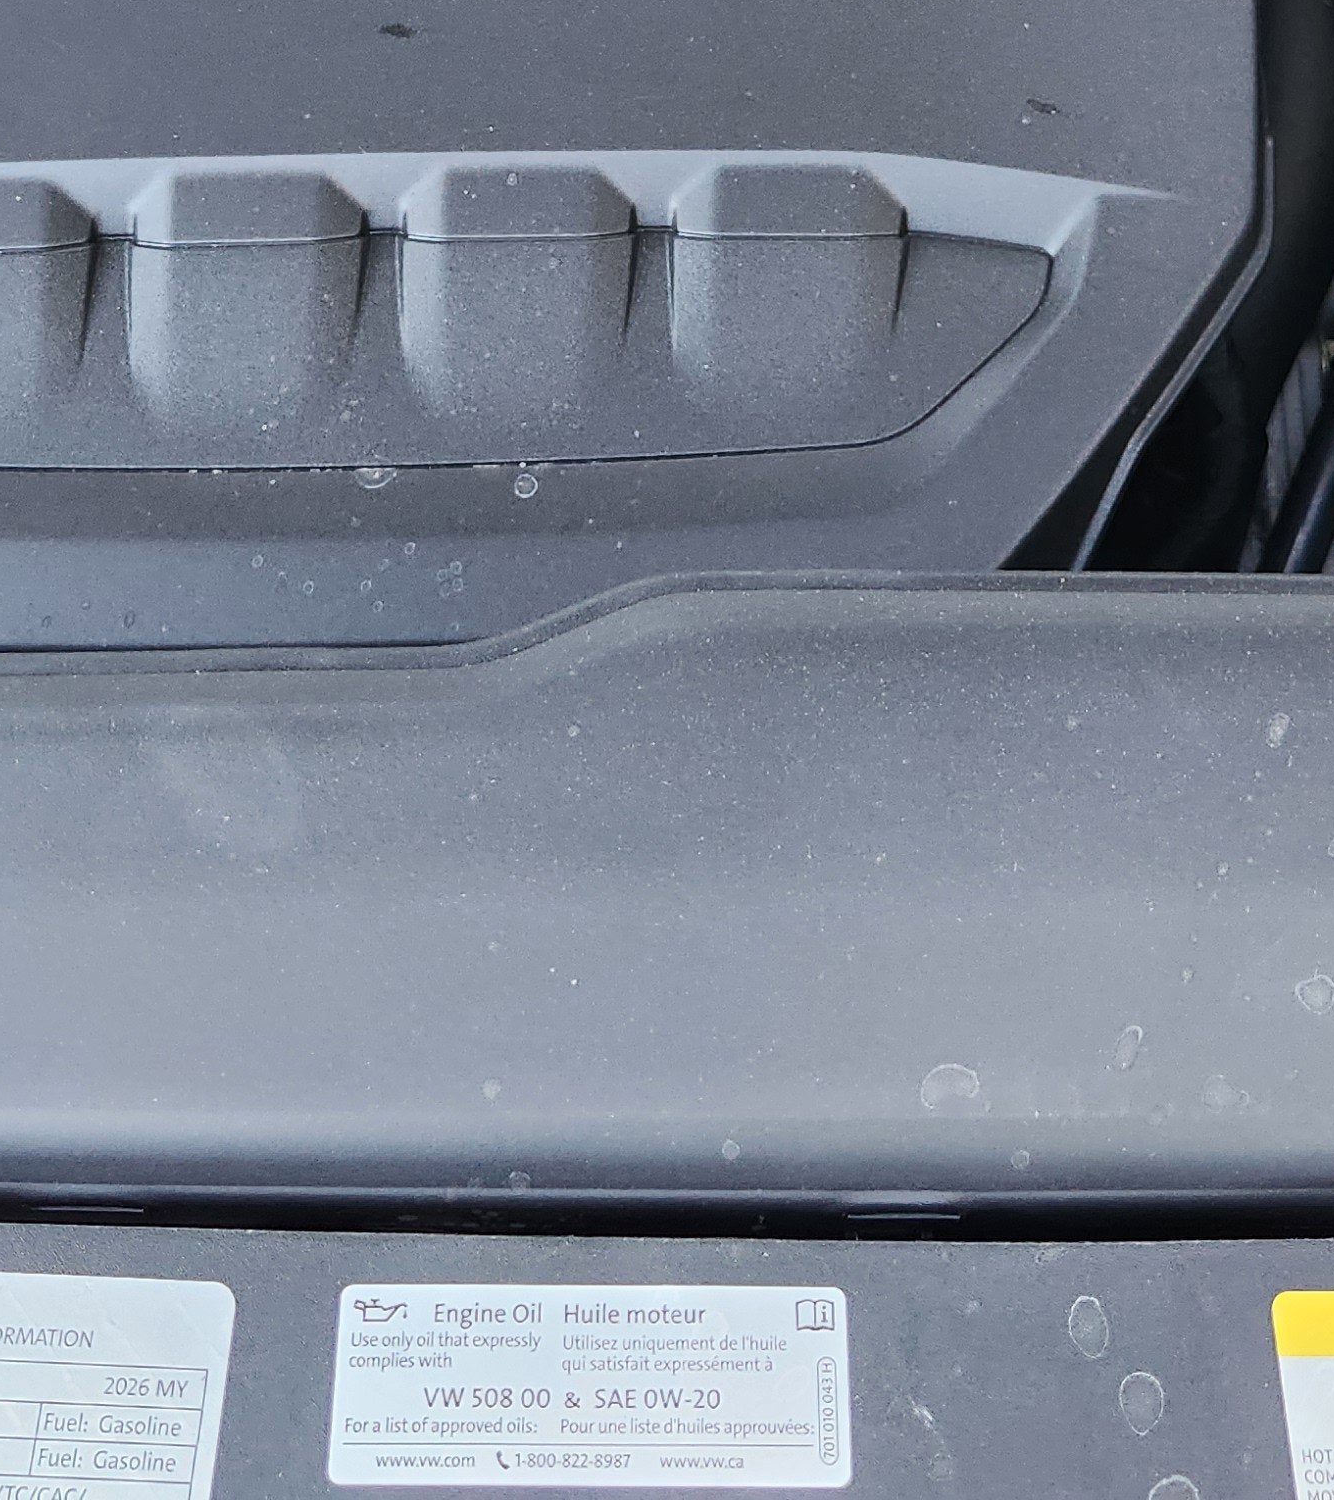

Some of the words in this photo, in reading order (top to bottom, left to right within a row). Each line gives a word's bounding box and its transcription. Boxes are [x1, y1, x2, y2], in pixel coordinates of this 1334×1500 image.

[434, 1302, 507, 1330] Engine
[512, 1301, 543, 1324] Oil
[563, 1302, 621, 1325] Huile
[626, 1305, 707, 1325] moteur
[350, 1332, 379, 1348] Use
[381, 1332, 414, 1352] only
[416, 1331, 435, 1348] oil
[437, 1331, 469, 1349] that
[471, 1332, 543, 1353] expressly
[562, 1334, 618, 1352] Utilisez
[622, 1336, 716, 1356] uniquement
[719, 1336, 739, 1352] de
[741, 1334, 788, 1352] l'huile
[348, 1352, 415, 1373] complies
[417, 1353, 453, 1369] with
[561, 1357, 587, 1375] qui
[589, 1356, 651, 1373] satisfait
[653, 1357, 761, 1376] expressément
[764, 1357, 774, 1373] à
[104, 1375, 150, 1397] 2026
[155, 1378, 190, 1399] MY
[423, 1386, 466, 1409] VW
[472, 1386, 514, 1409] 508
[520, 1387, 551, 1410] 00
[563, 1391, 581, 1410] &
[594, 1388, 637, 1409] SAE
[643, 1388, 722, 1410] 0W-20
[820, 1376, 835, 1404] 043
[42, 1411, 89, 1434] Fuel:
[98, 1414, 183, 1437] Gasoline
[344, 1416, 369, 1434] For
[371, 1420, 382, 1434] a
[384, 1416, 408, 1434] list
[411, 1416, 430, 1434] of
[429, 1417, 503, 1438] approved
[506, 1417, 539, 1434] oils:
[559, 1417, 595, 1435] Pour
[597, 1420, 627, 1435] une
[630, 1417, 661, 1435] liste
[663, 1417, 721, 1436] d'huiles
[723, 1418, 815, 1440] approuvées:
[822, 1436, 836, 1460] 701
[1301, 1447, 1334, 1465] HOT
[36, 1447, 83, 1469] Fuel:
[92, 1450, 178, 1473] Gasoline
[375, 1453, 476, 1469] www.vw.com
[515, 1451, 632, 1470] 1-800-822-8987
[659, 1455, 745, 1470] www.vw.ca
